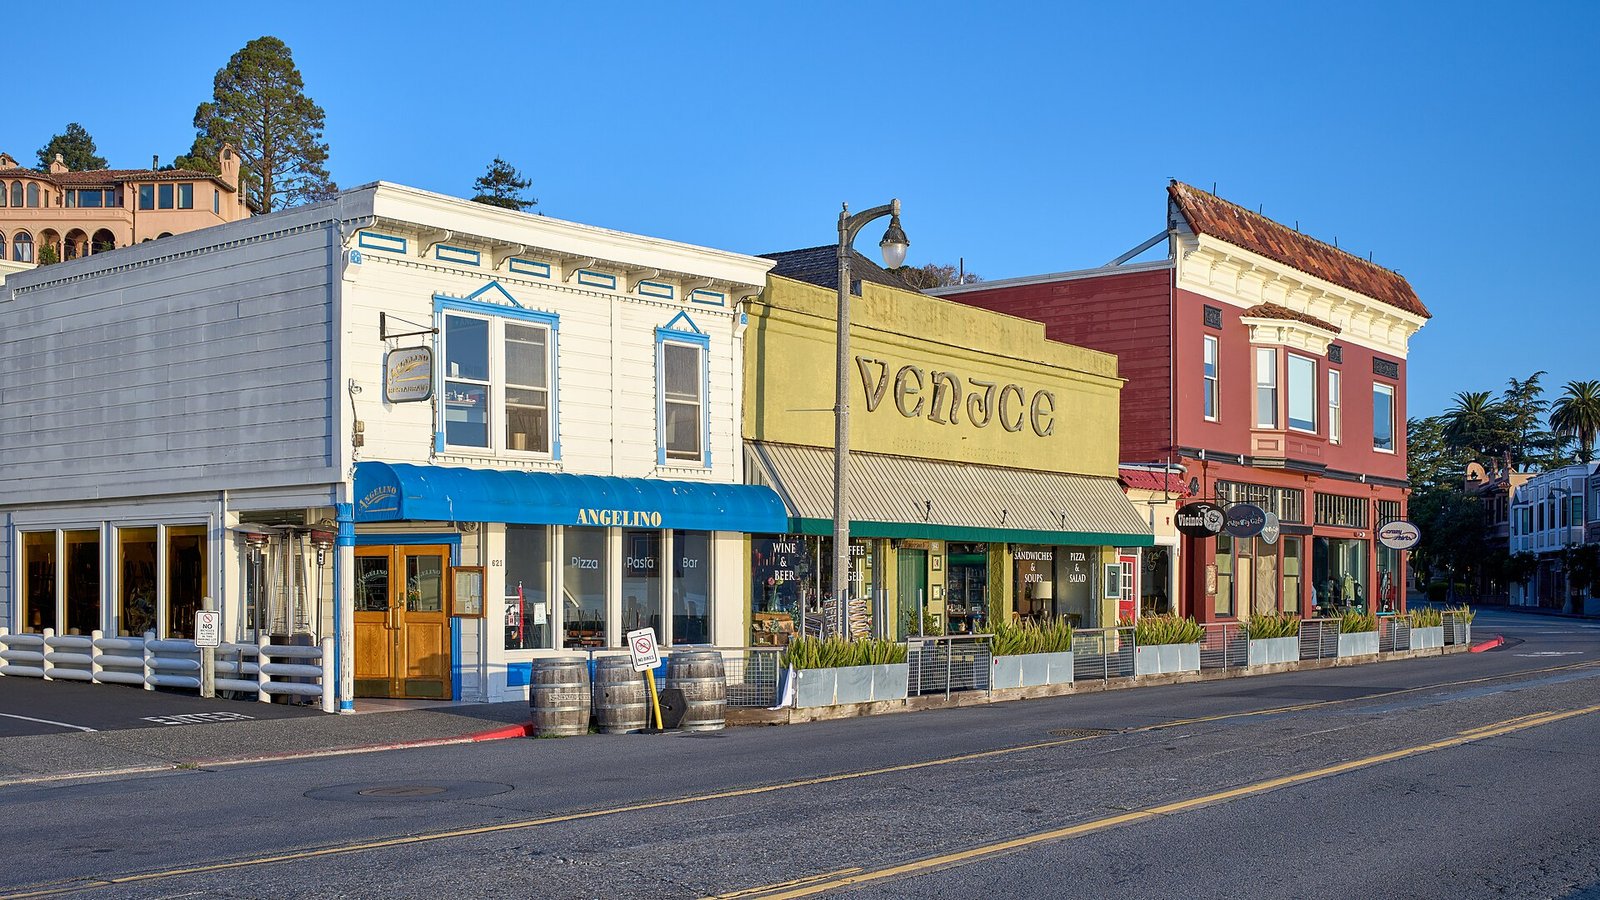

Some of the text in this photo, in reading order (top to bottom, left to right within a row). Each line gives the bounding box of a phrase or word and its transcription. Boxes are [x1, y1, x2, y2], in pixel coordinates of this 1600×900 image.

[387, 354, 429, 385] ANGELINO
[358, 485, 397, 513] ANGELINO
[576, 508, 662, 527] ANGELINO
[1178, 512, 1203, 527] Vicino's
[773, 543, 796, 554] WINE
[848, 545, 865, 556] FFEE
[780, 556, 787, 567] &
[1014, 551, 1053, 561] SANDWICHES
[1070, 552, 1086, 562] PIZZA
[491, 559, 503, 567] 621
[571, 556, 598, 569] Pizza
[627, 556, 654, 569] Pasta
[682, 557, 698, 568] Bar
[1030, 562, 1036, 572] &
[1074, 563, 1080, 572] &
[356, 569, 388, 587] ANGELINO
[774, 570, 795, 581] BEER
[847, 571, 865, 582] GELS
[1024, 573, 1043, 583] SOUPS
[1069, 574, 1087, 583] SALAD
[139, 711, 255, 725] ENTER
